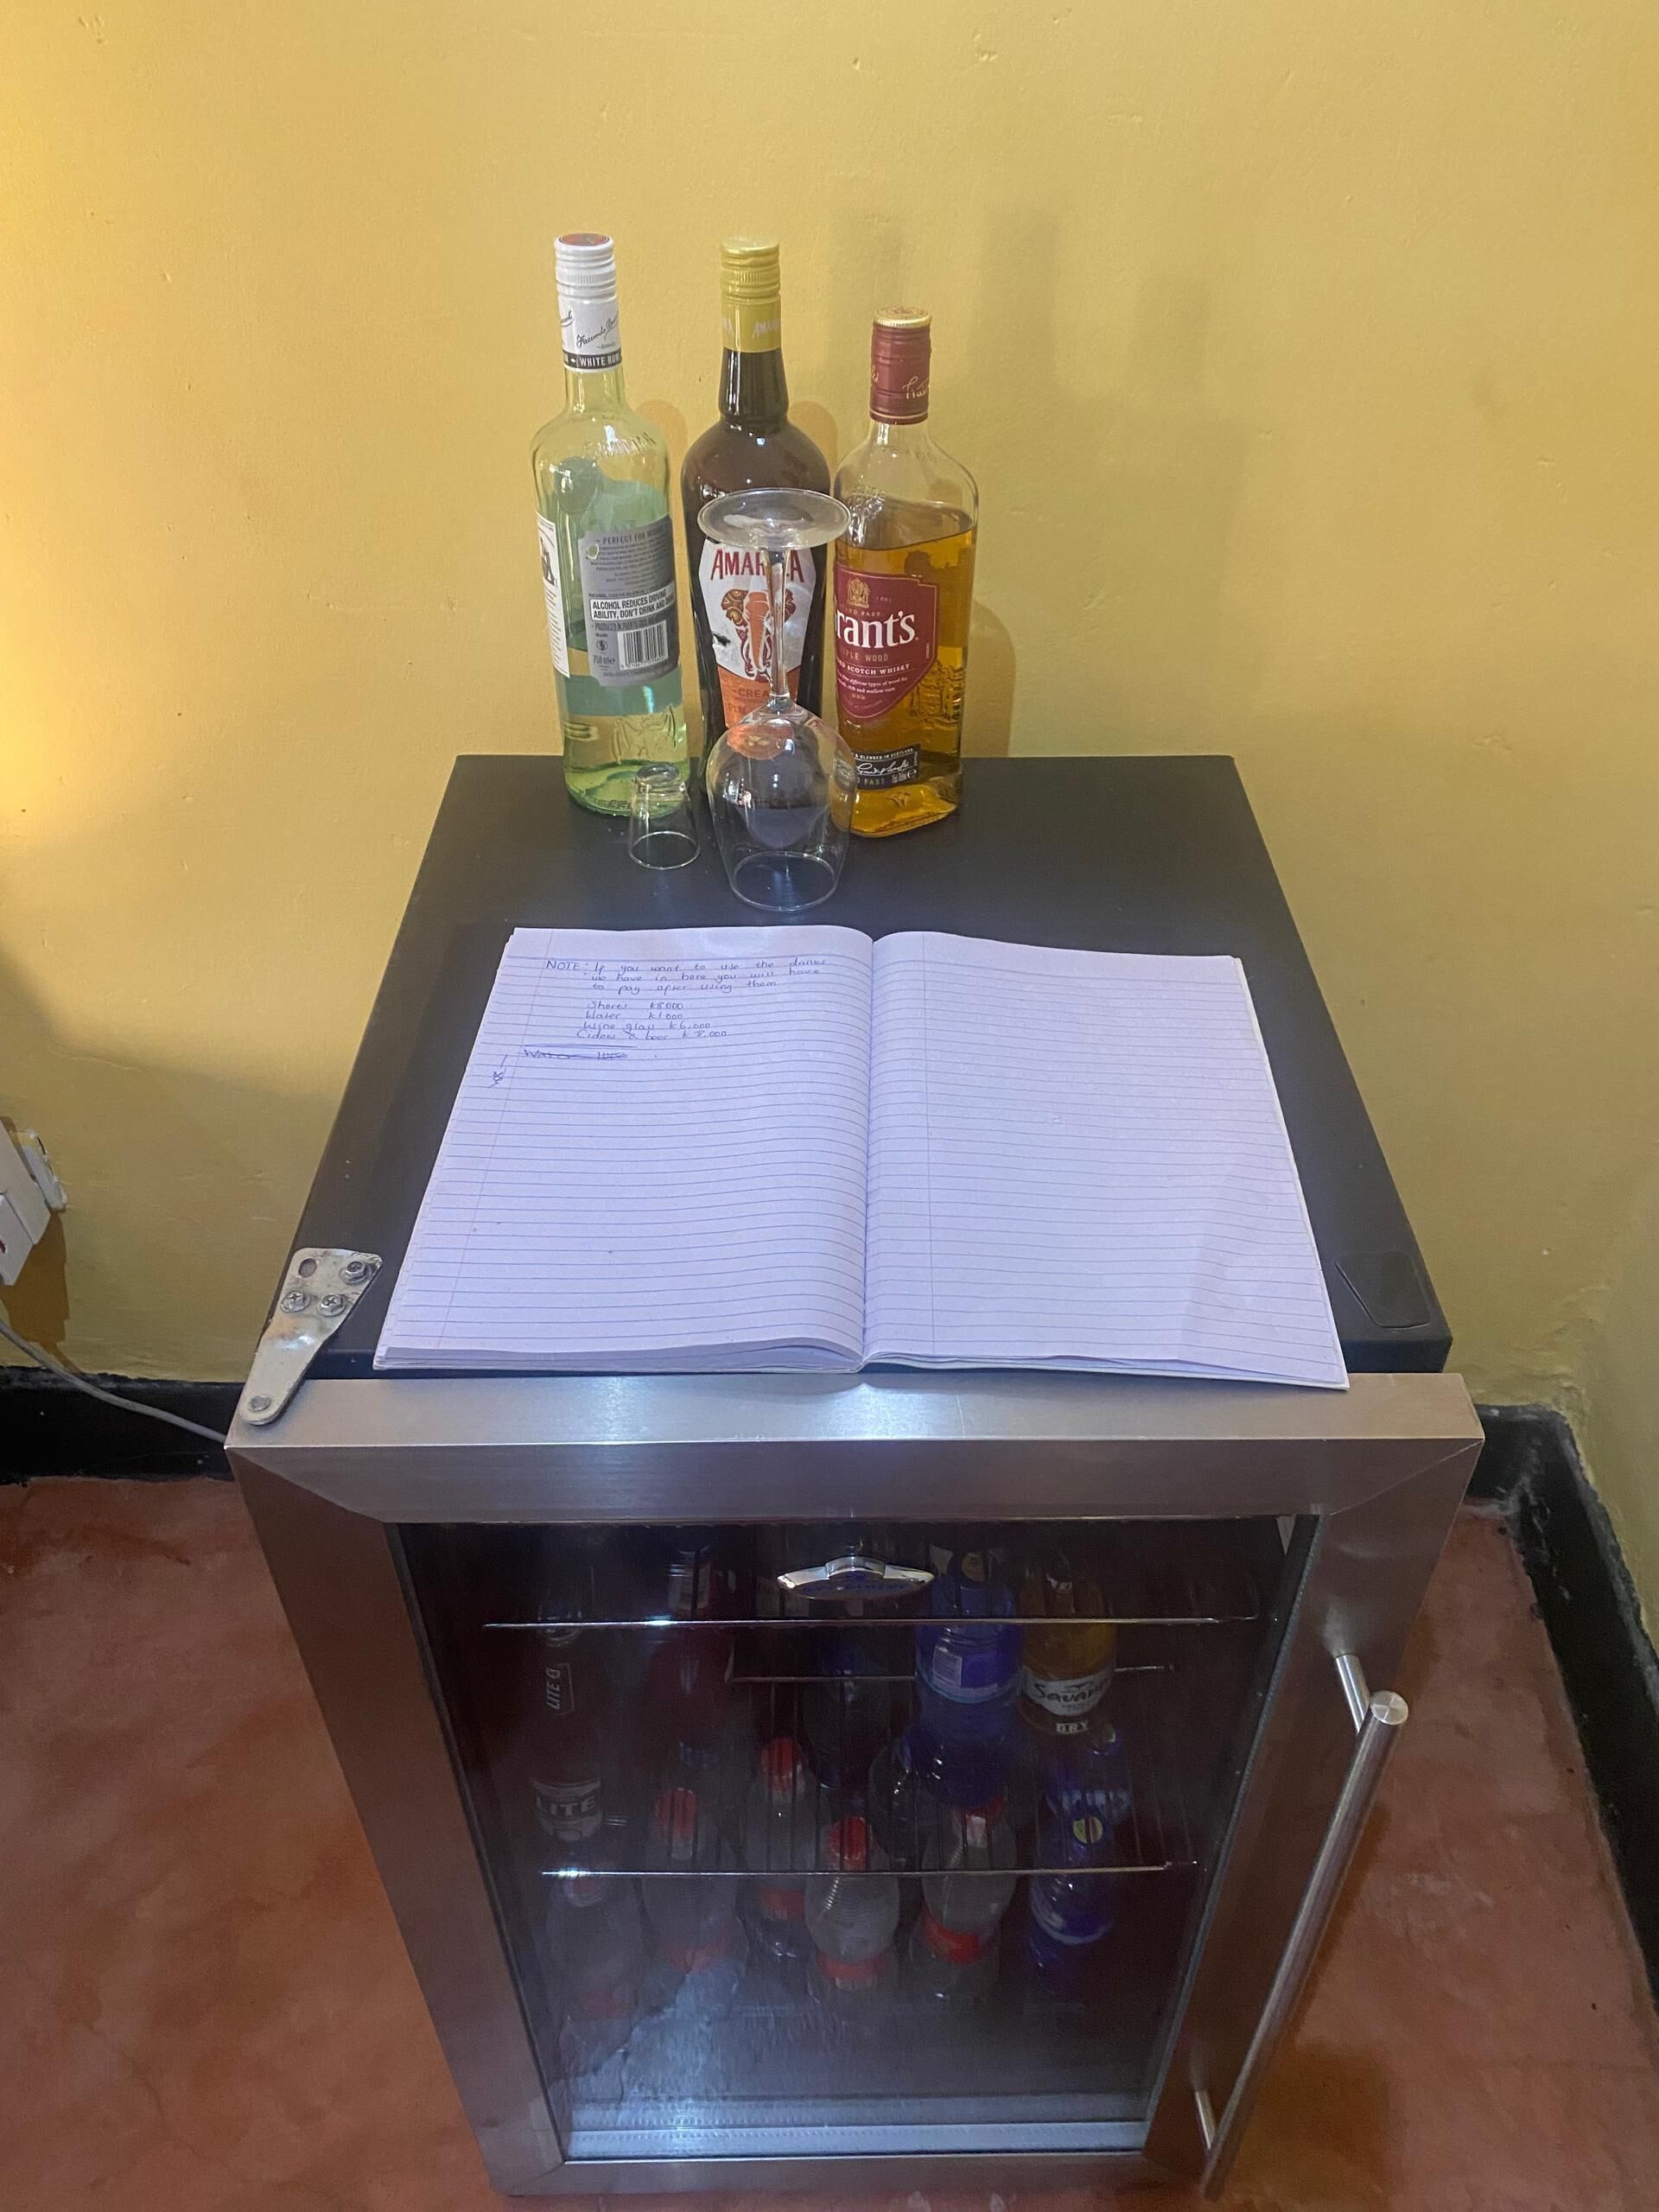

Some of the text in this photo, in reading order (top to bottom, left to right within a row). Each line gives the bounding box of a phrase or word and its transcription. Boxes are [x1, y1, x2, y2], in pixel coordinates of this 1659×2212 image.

[580, 356, 606, 367] WHITE
[602, 535, 632, 545] PERFECT
[710, 548, 804, 582] AMARA
[593, 601, 621, 610] ALCOHOL
[622, 596, 648, 609] REDUCES
[648, 589, 667, 603] DRIVING
[594, 610, 620, 620] ABILITY,
[620, 608, 638, 619] DON'T
[639, 604, 656, 615] DRINK
[656, 600, 666, 610] AND
[836, 610, 916, 649] rant's
[865, 653, 889, 663] WOOD
[847, 663, 912, 676] SCOTCH WHISKY
[738, 688, 770, 699] CREA
[616, 973, 642, 982] have
[681, 970, 706, 981] here
[715, 974, 737, 983] you
[749, 970, 774, 979] will
[789, 967, 820, 976] have
[620, 964, 639, 976] you
[651, 963, 681, 972] want
[754, 960, 775, 969] the
[617, 985, 641, 995] pay
[656, 984, 687, 995] after
[700, 984, 734, 994] using
[746, 980, 777, 988] them
[546, 1681, 560, 1710] LITE
[536, 1791, 596, 1817] LITE
